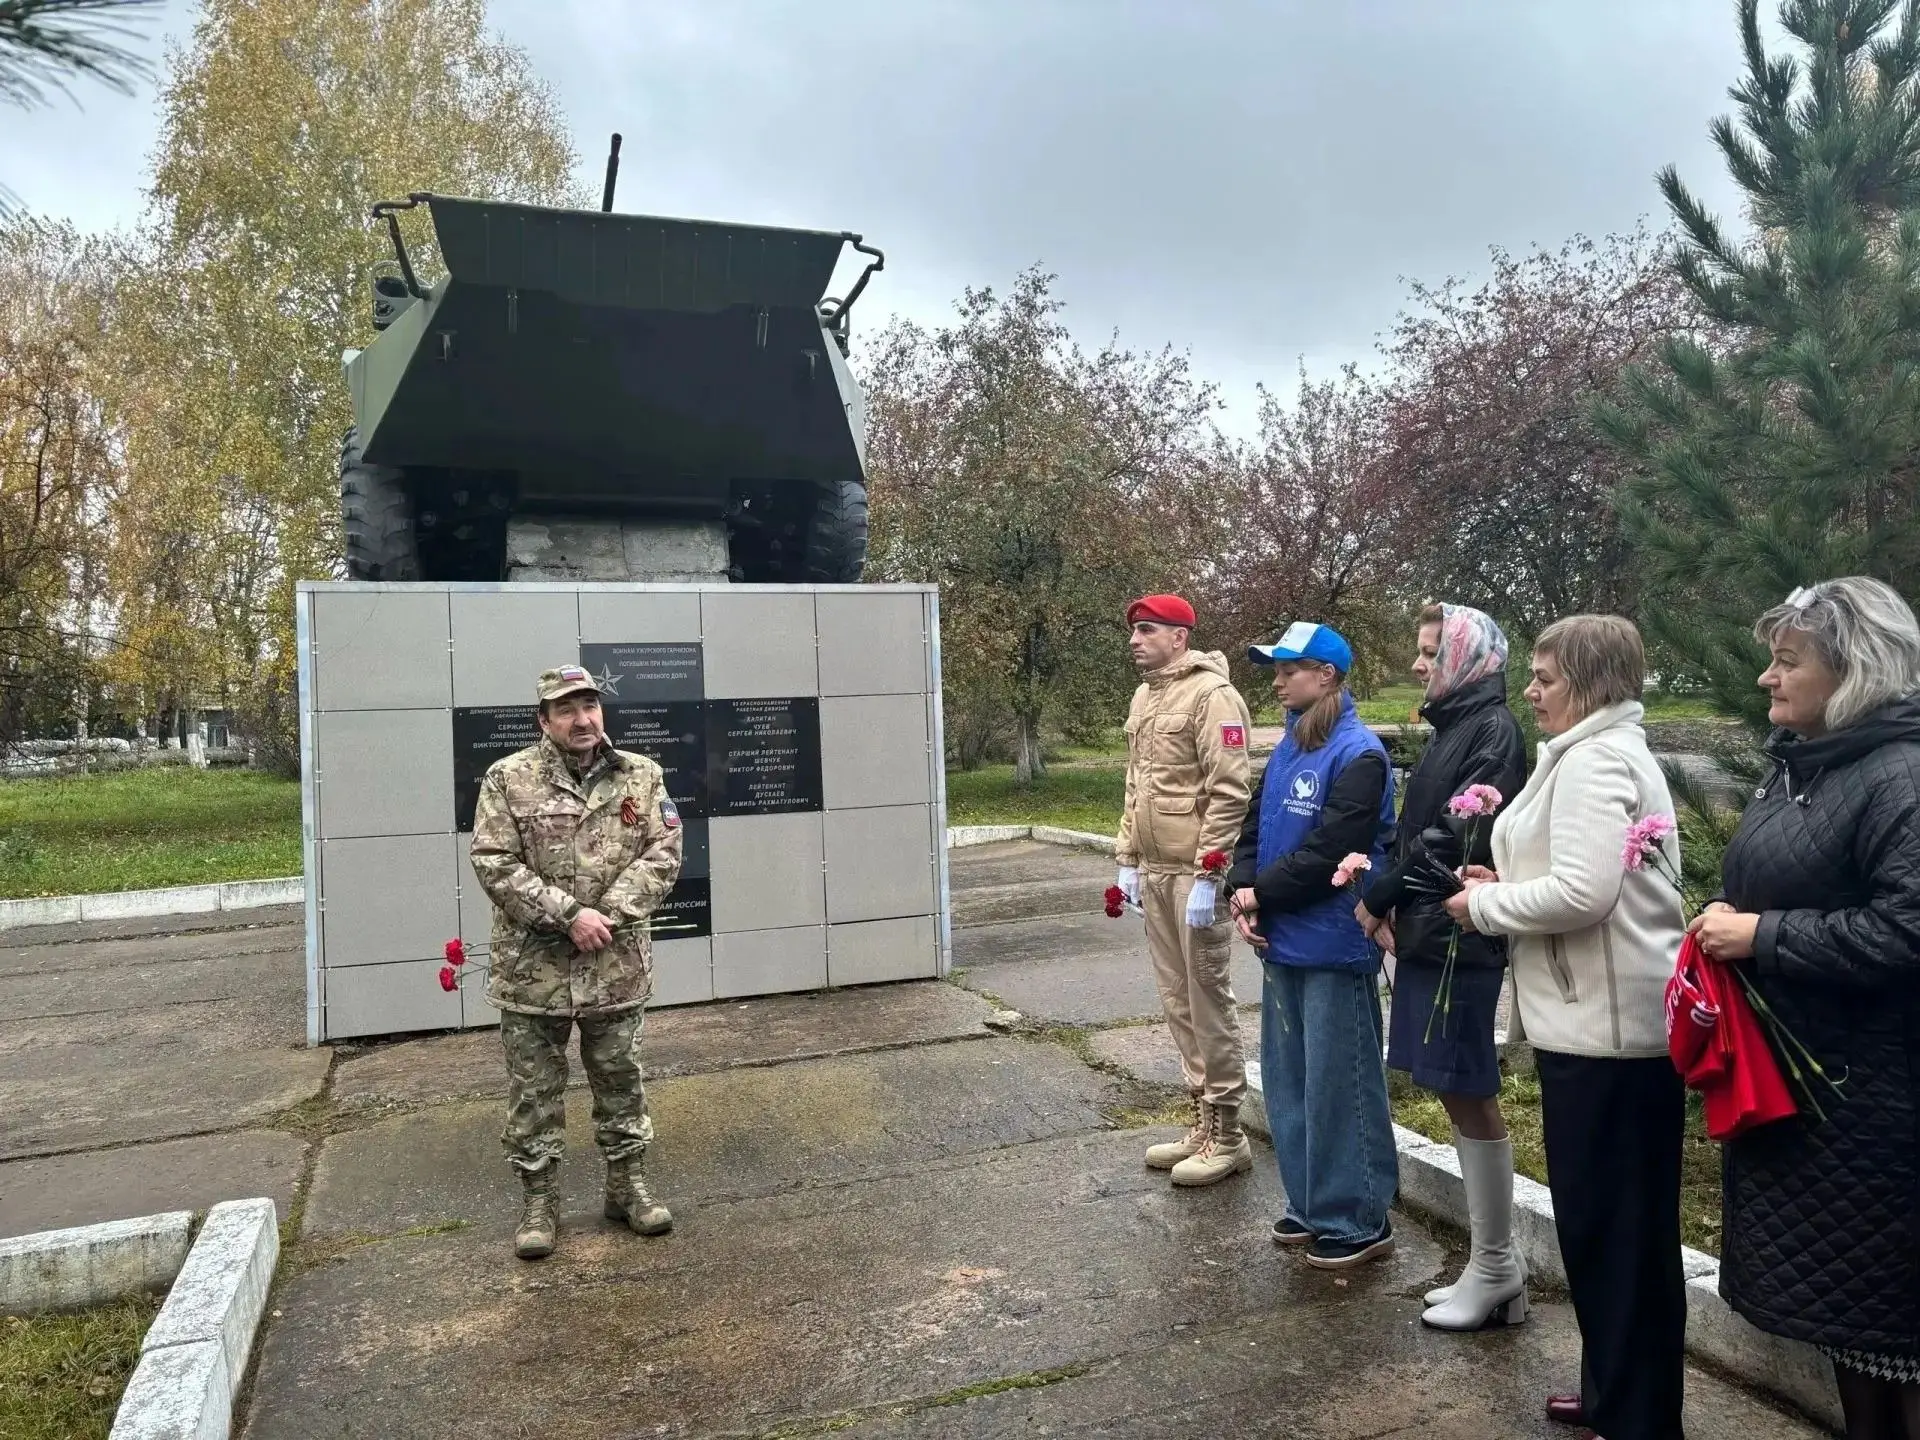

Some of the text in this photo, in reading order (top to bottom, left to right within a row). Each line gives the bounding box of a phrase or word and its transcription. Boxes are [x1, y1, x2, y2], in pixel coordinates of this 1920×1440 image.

[746, 715, 776, 723] КАПИТАН
[630, 722, 661, 730] РЯДОВОЙ
[490, 731, 541, 739] ОМЕЛЬЧЕНКО
[624, 729, 670, 737] НЕПОМНЯЩИЙ
[727, 728, 797, 737] СЕРГЕЙ НИКОЛАЕВИЧ
[472, 741, 503, 749] ВИКТОР
[761, 748, 798, 756] ЛЕЙТЕНАНТ
[748, 782, 787, 790] ЛЕЙТЕНАНТ
[755, 791, 785, 799] ДУСКАЕВ
[673, 900, 707, 909] РОССИИ
